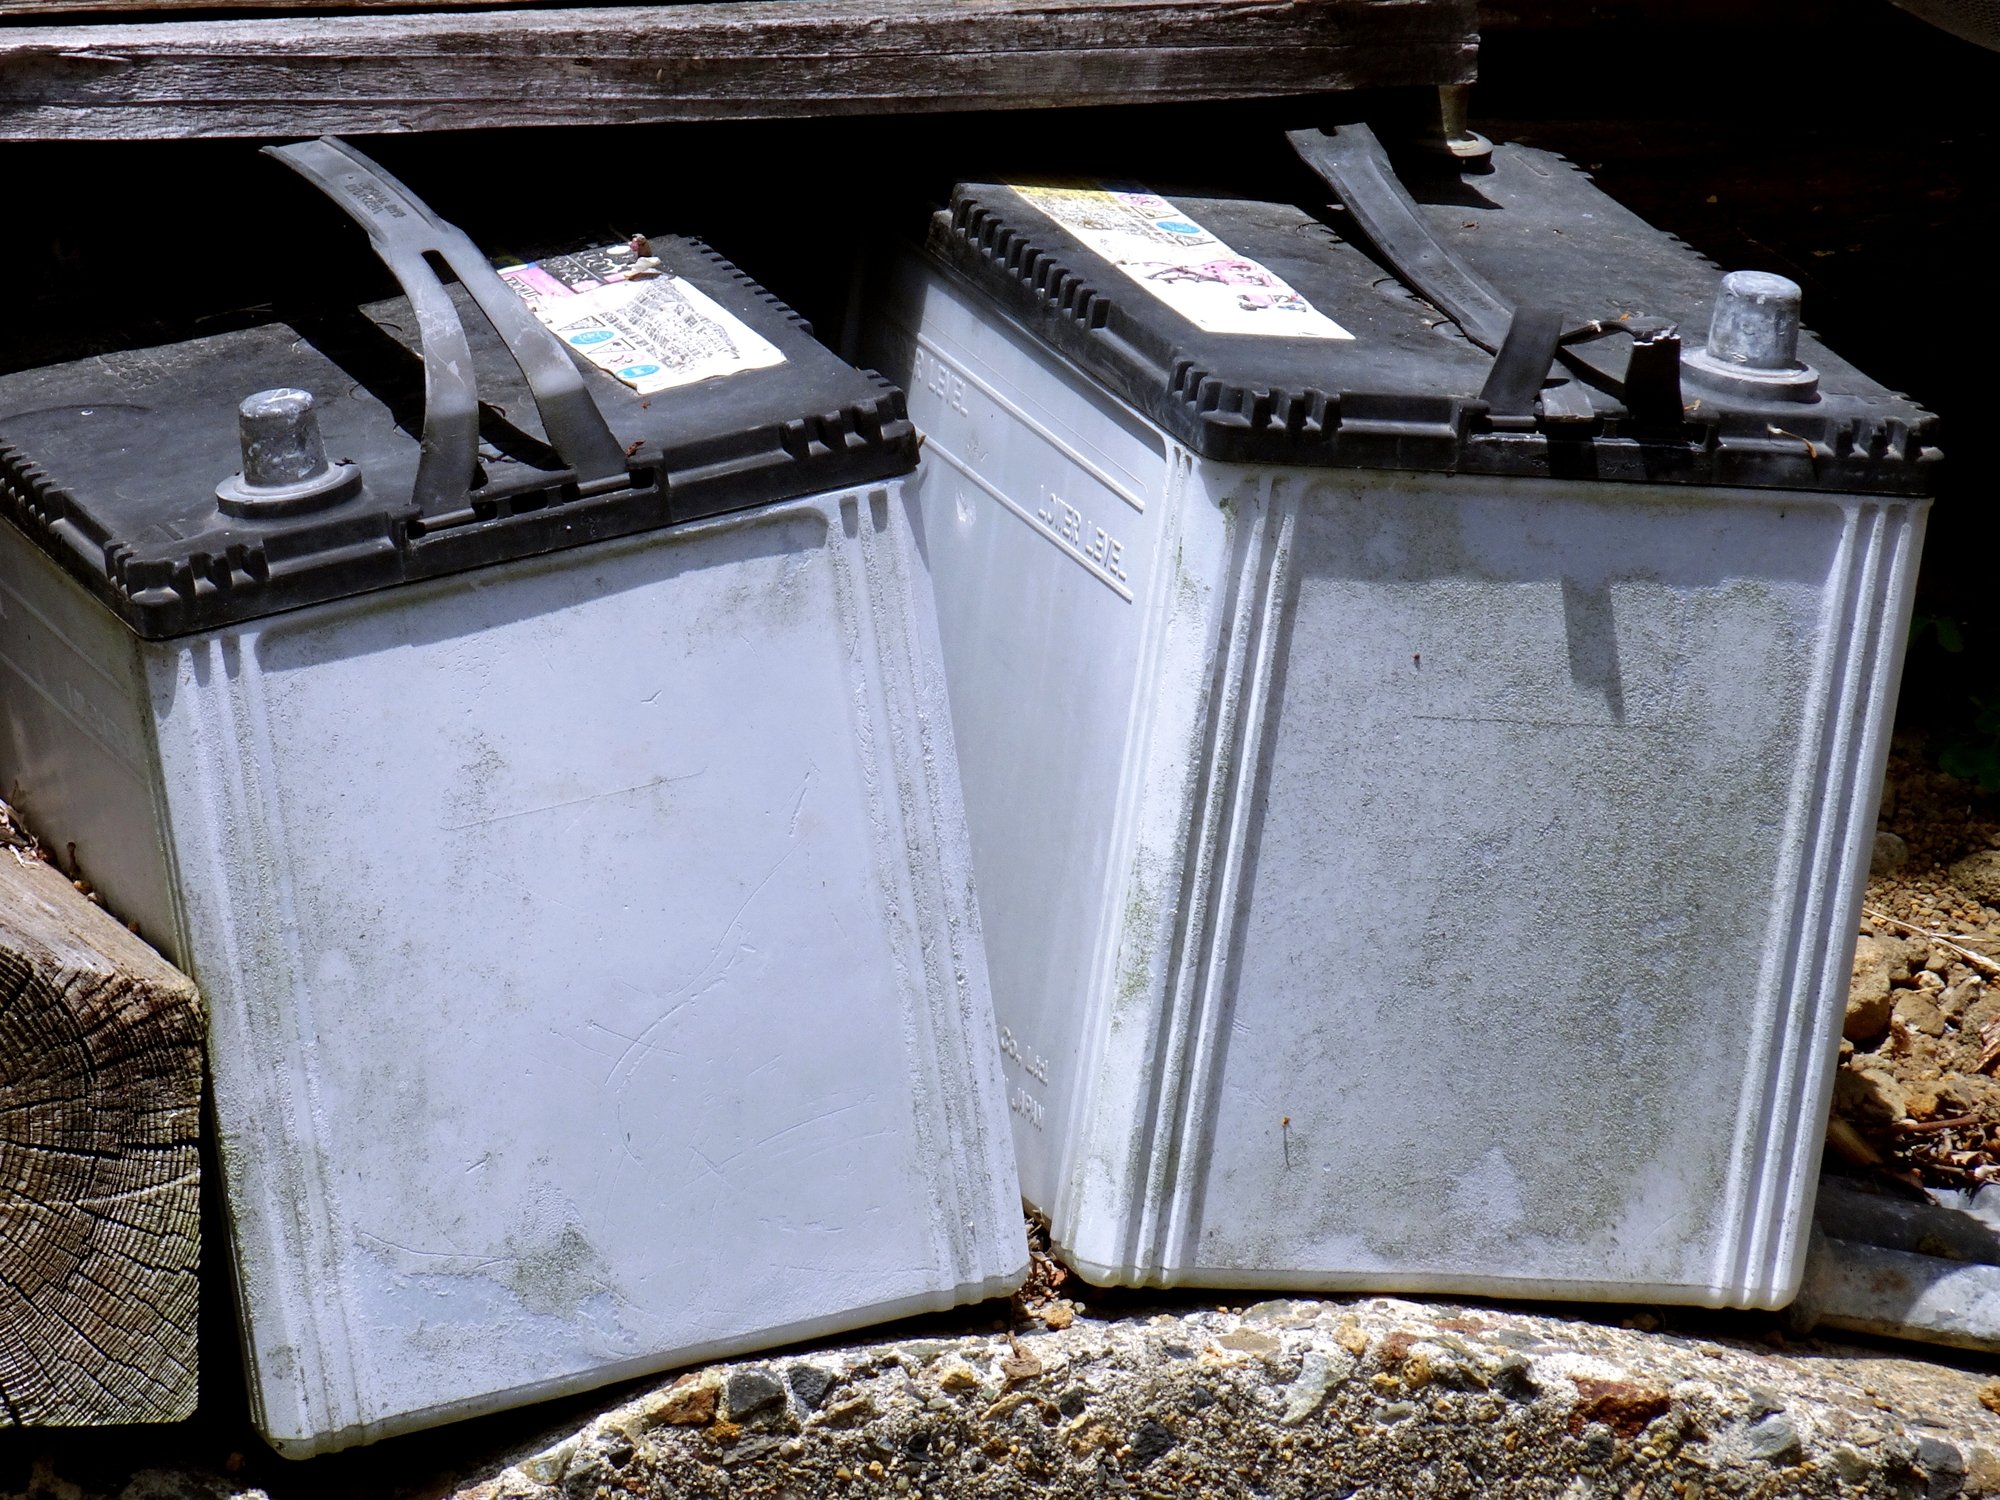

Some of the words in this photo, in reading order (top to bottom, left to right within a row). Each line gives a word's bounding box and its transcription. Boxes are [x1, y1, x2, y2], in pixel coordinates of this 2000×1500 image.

[1038, 484, 1081, 545] LOWER
[1085, 520, 1127, 581] LEVEL
[1011, 1087, 1045, 1132] JAPAN
